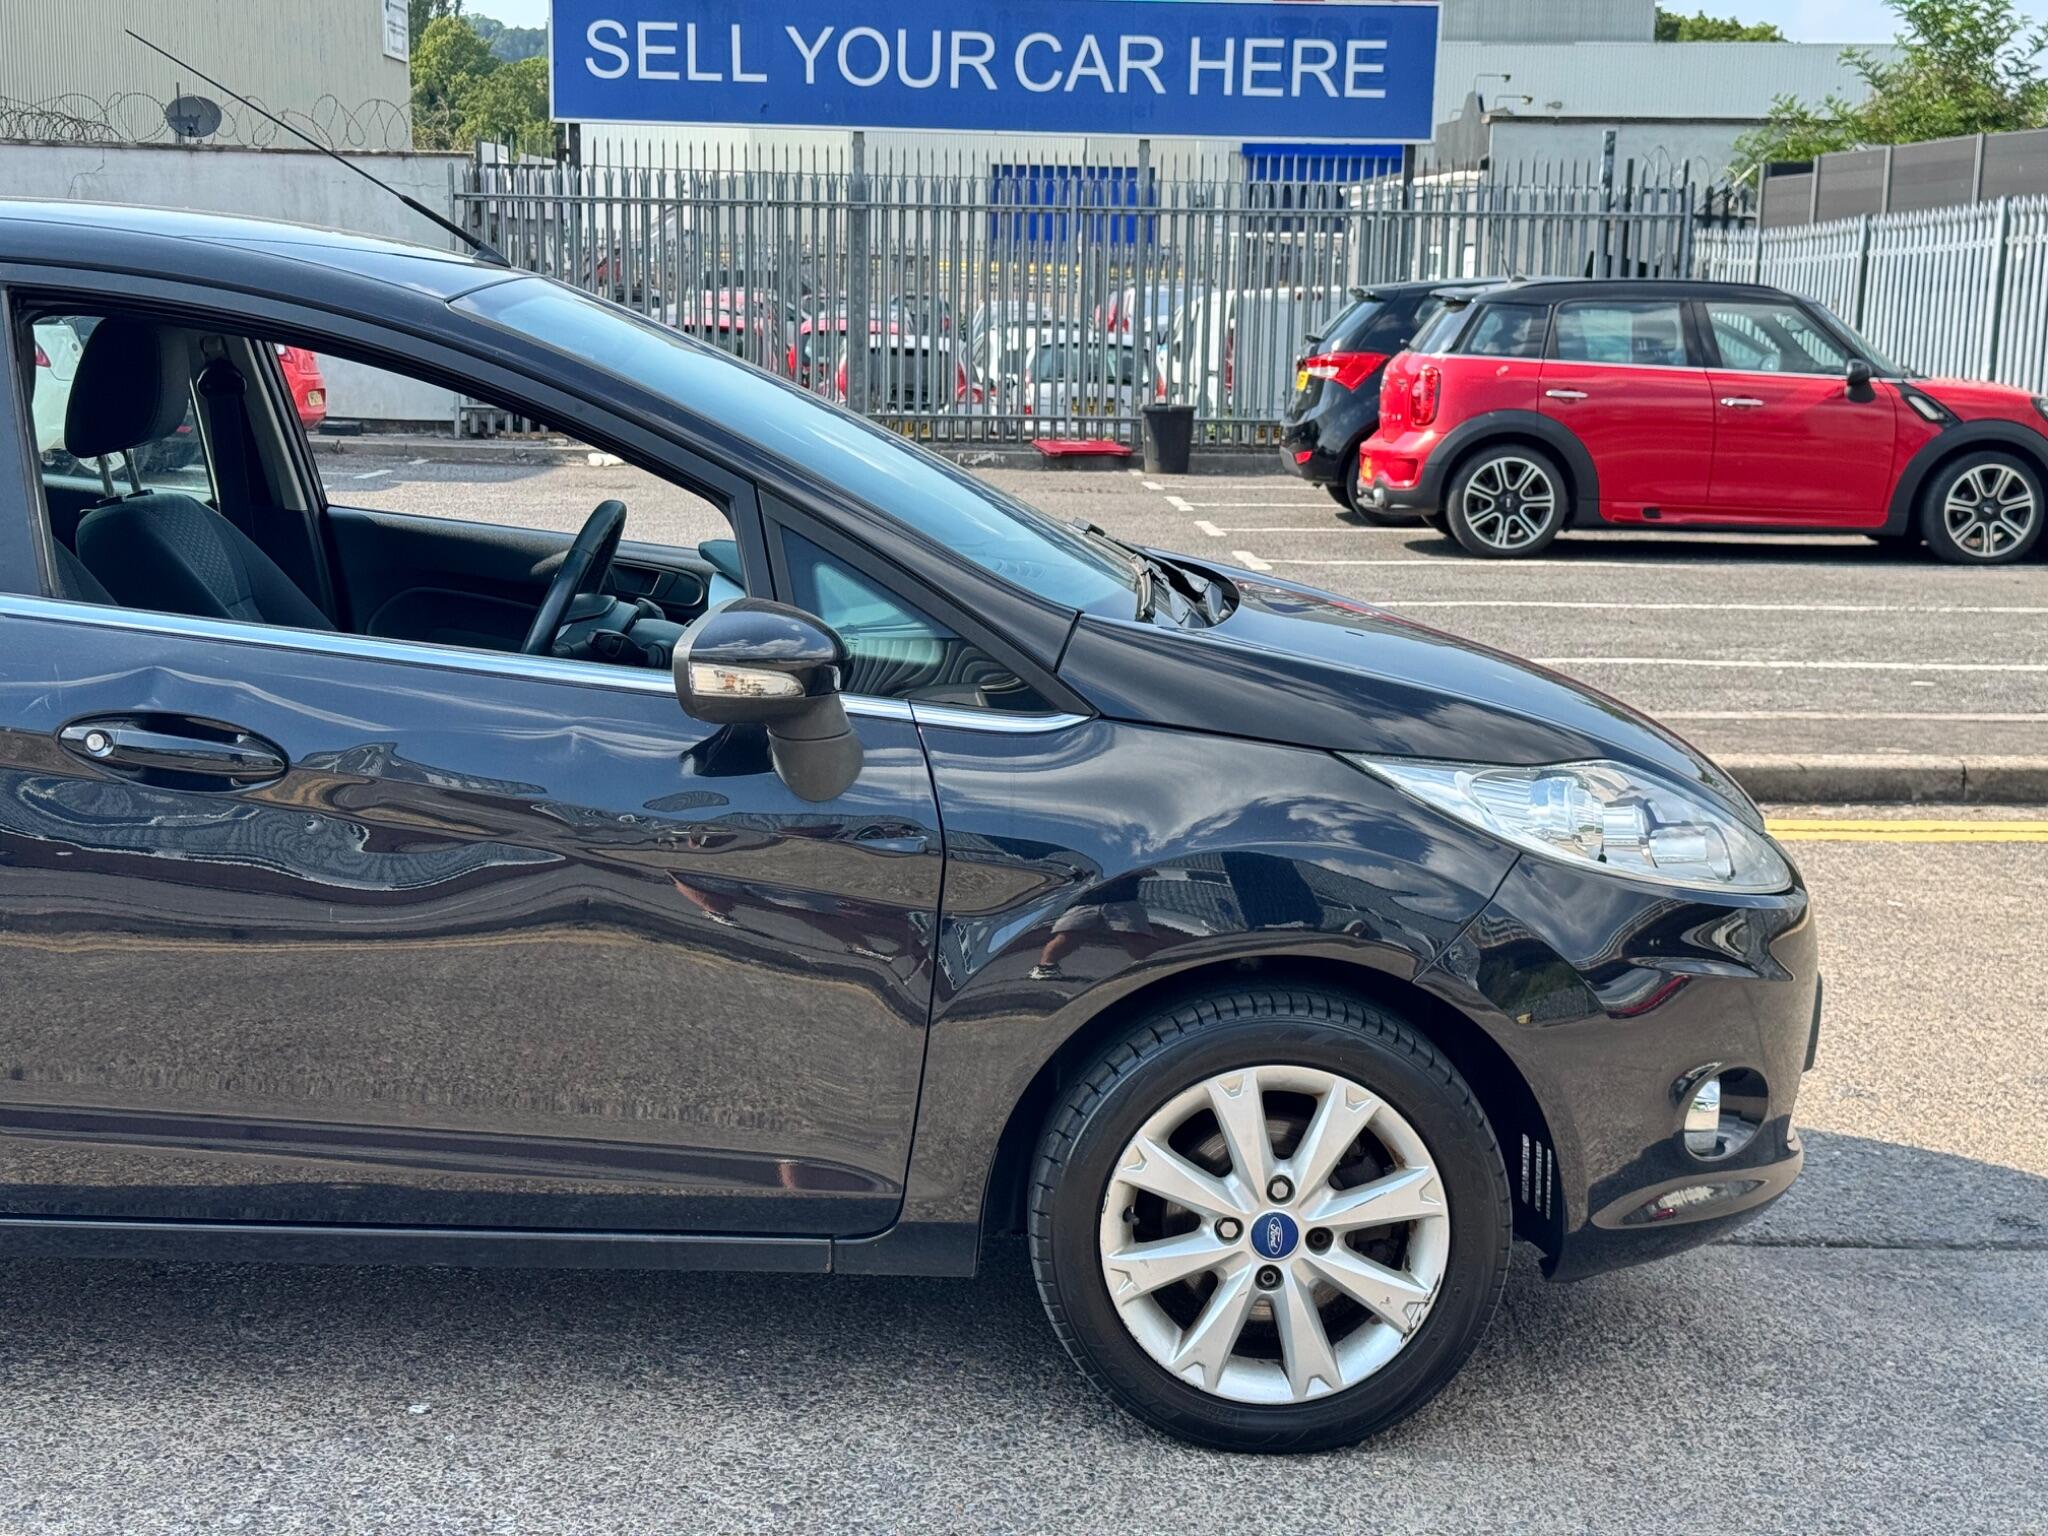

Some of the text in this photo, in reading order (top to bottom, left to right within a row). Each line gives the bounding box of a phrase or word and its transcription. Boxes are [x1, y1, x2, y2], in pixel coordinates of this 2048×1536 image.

[585, 19, 1388, 98] SELL YOUR CAR HERE
[1269, 1223, 1281, 1249] Ford
